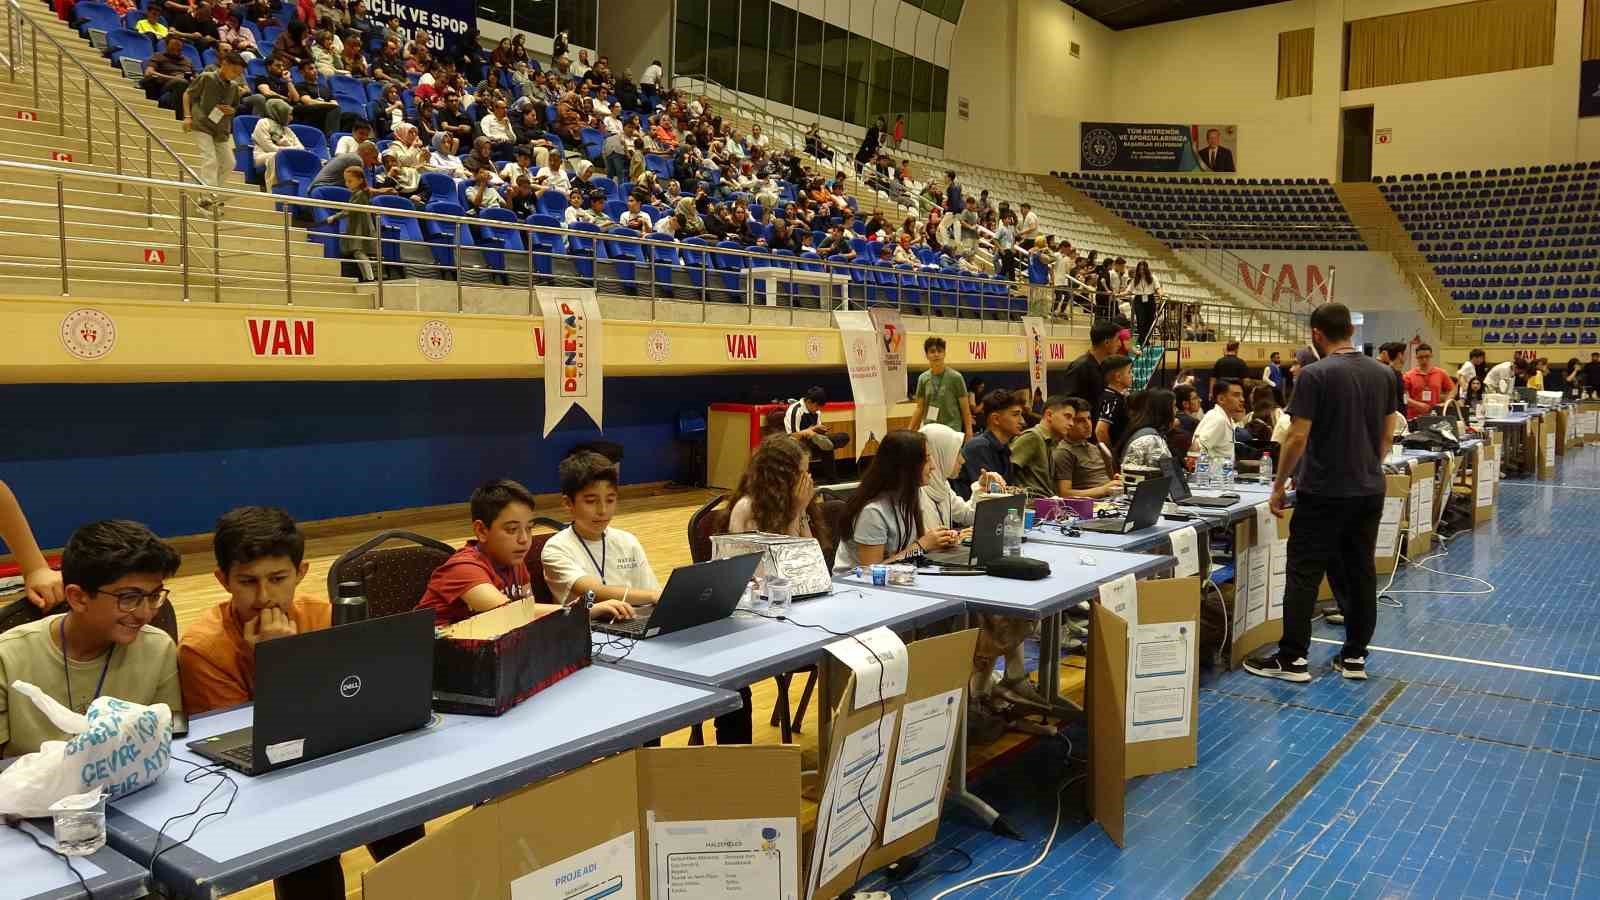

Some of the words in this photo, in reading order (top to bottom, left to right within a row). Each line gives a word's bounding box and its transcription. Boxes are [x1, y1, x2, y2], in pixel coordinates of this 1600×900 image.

[409, 7, 429, 26] VE
[148, 251, 161, 263] A
[1237, 262, 1336, 303] VAN
[247, 319, 314, 356] VAN
[560, 303, 577, 392] DENEYAP
[726, 334, 757, 359] VAN
[969, 340, 987, 360] VAN
[1050, 343, 1065, 360] VAN
[342, 681, 359, 691] DELL
[554, 868, 583, 888] PROJE
[582, 862, 598, 877] ADI
